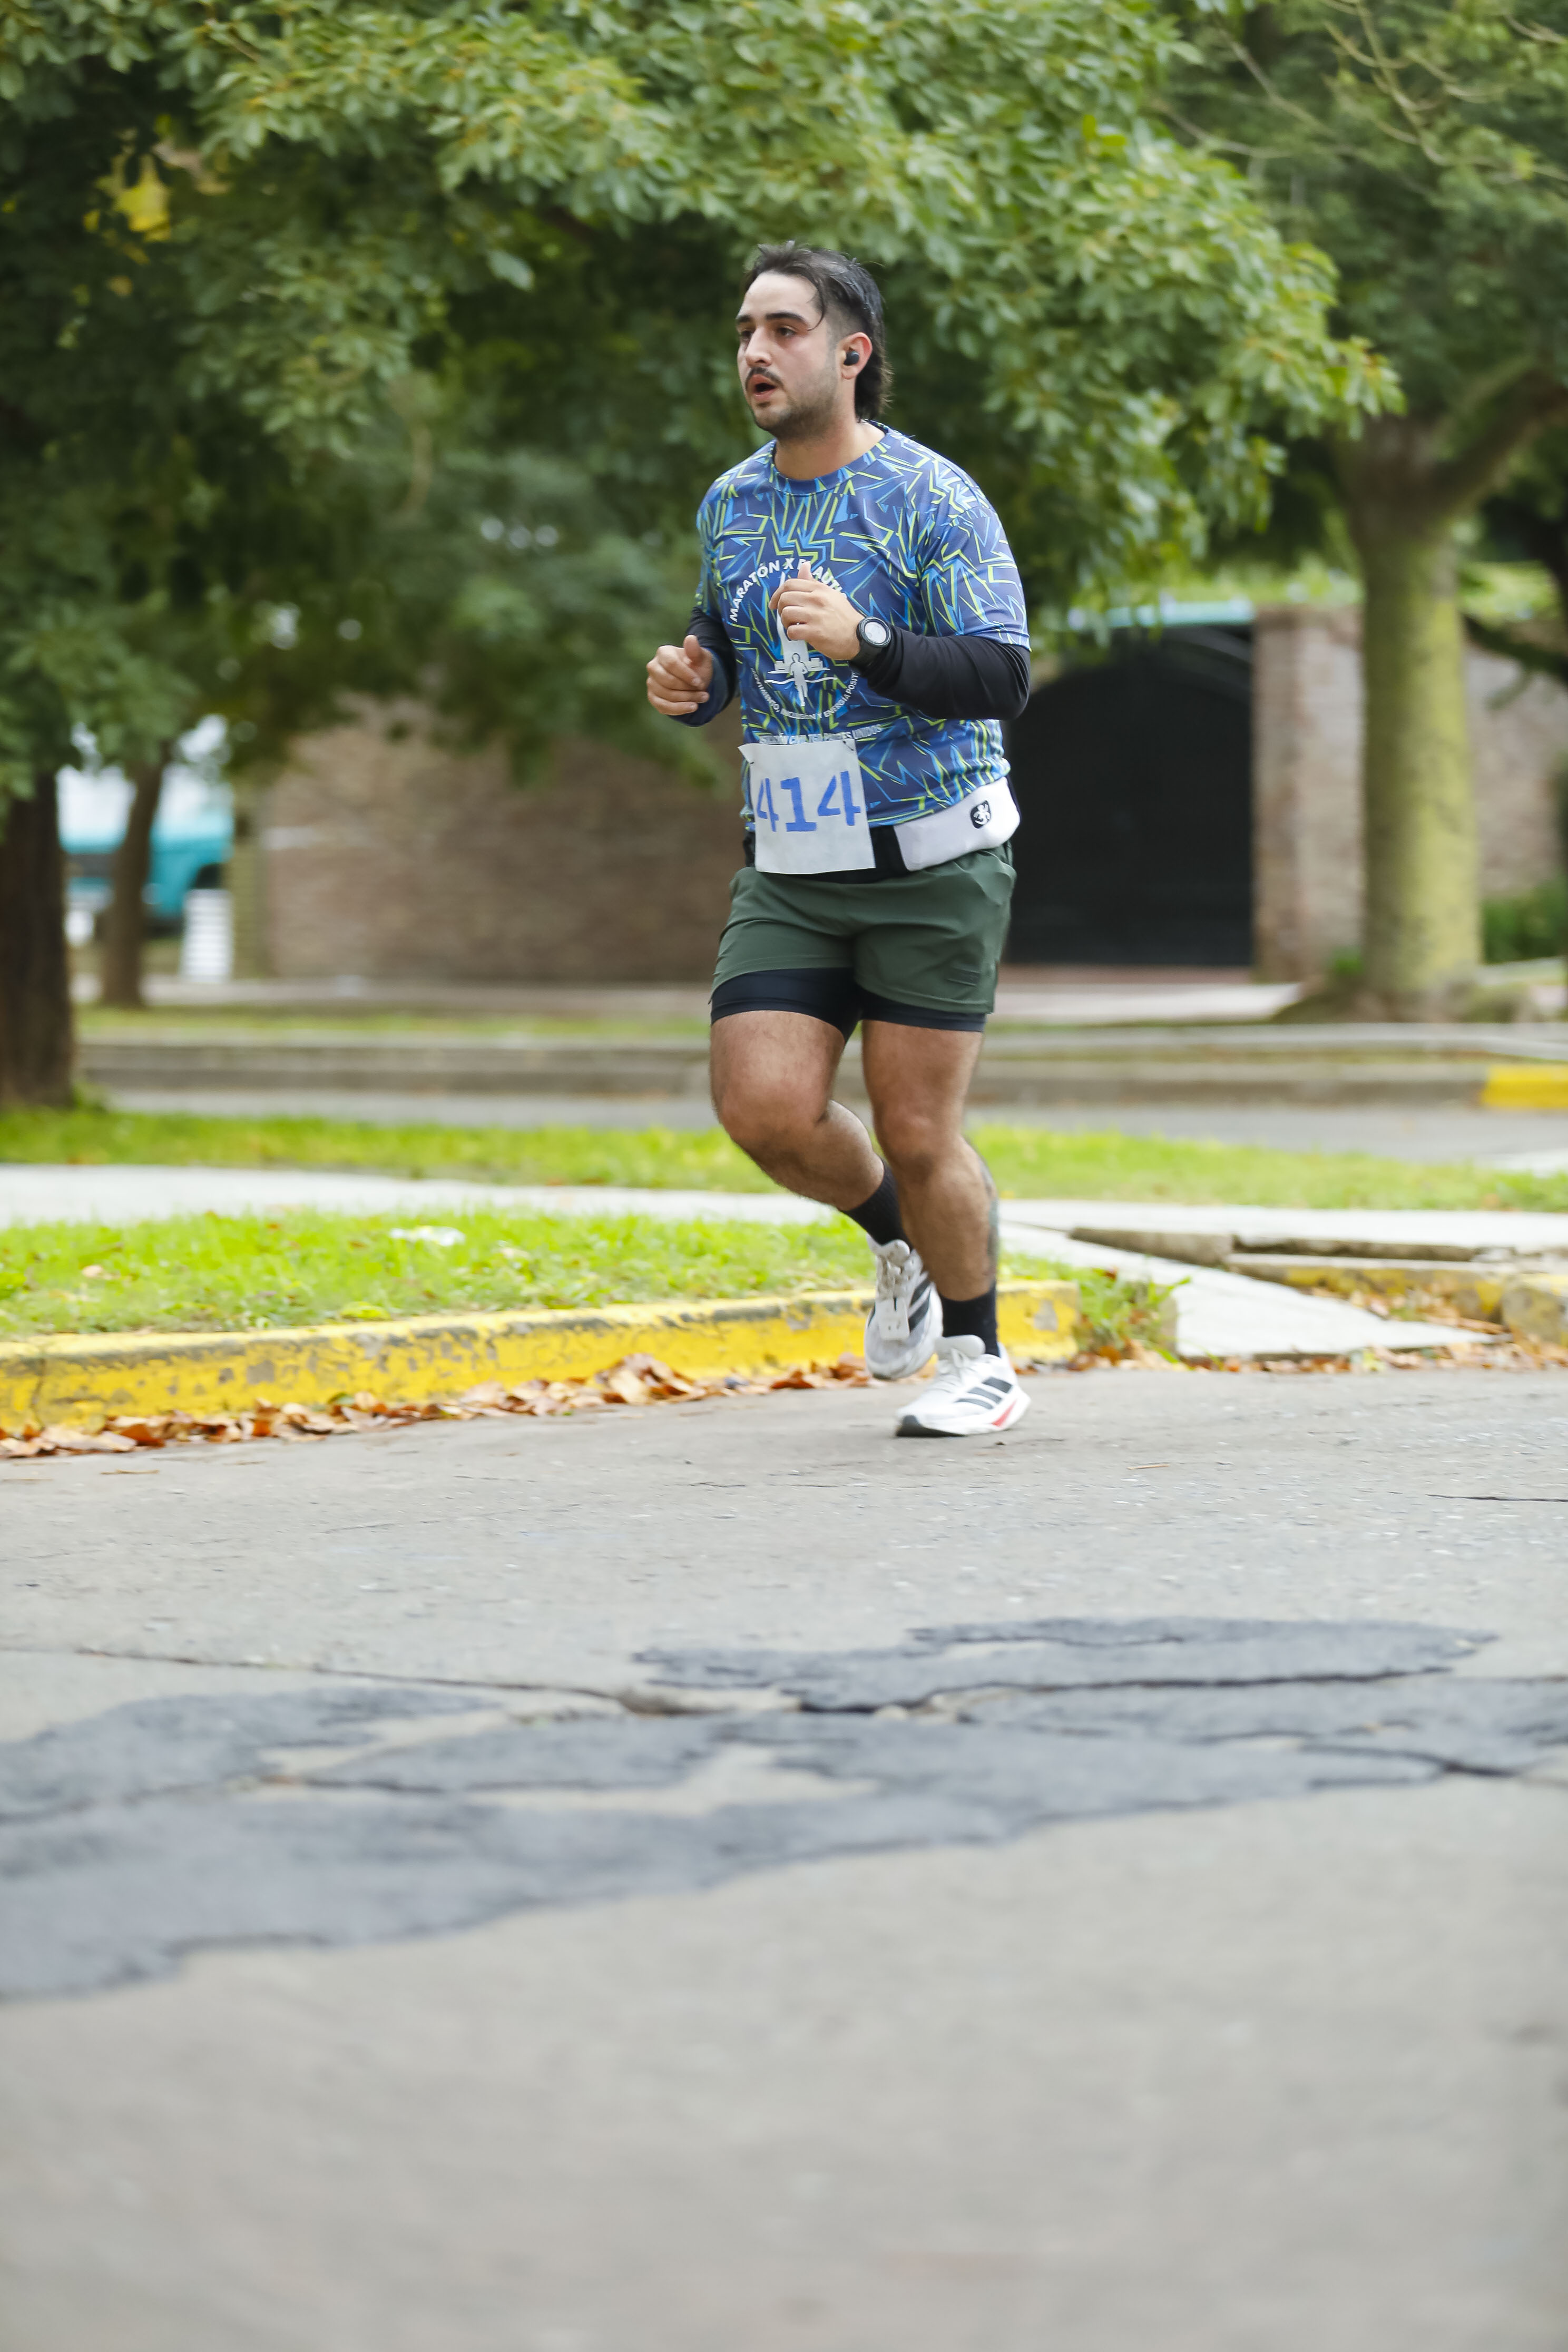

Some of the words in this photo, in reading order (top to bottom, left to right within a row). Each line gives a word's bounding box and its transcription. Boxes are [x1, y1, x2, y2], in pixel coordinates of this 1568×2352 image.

[729, 560, 780, 622] MARATÓN
[783, 558, 795, 570] X
[846, 672, 858, 694] POSIT
[756, 770, 861, 832] 414
